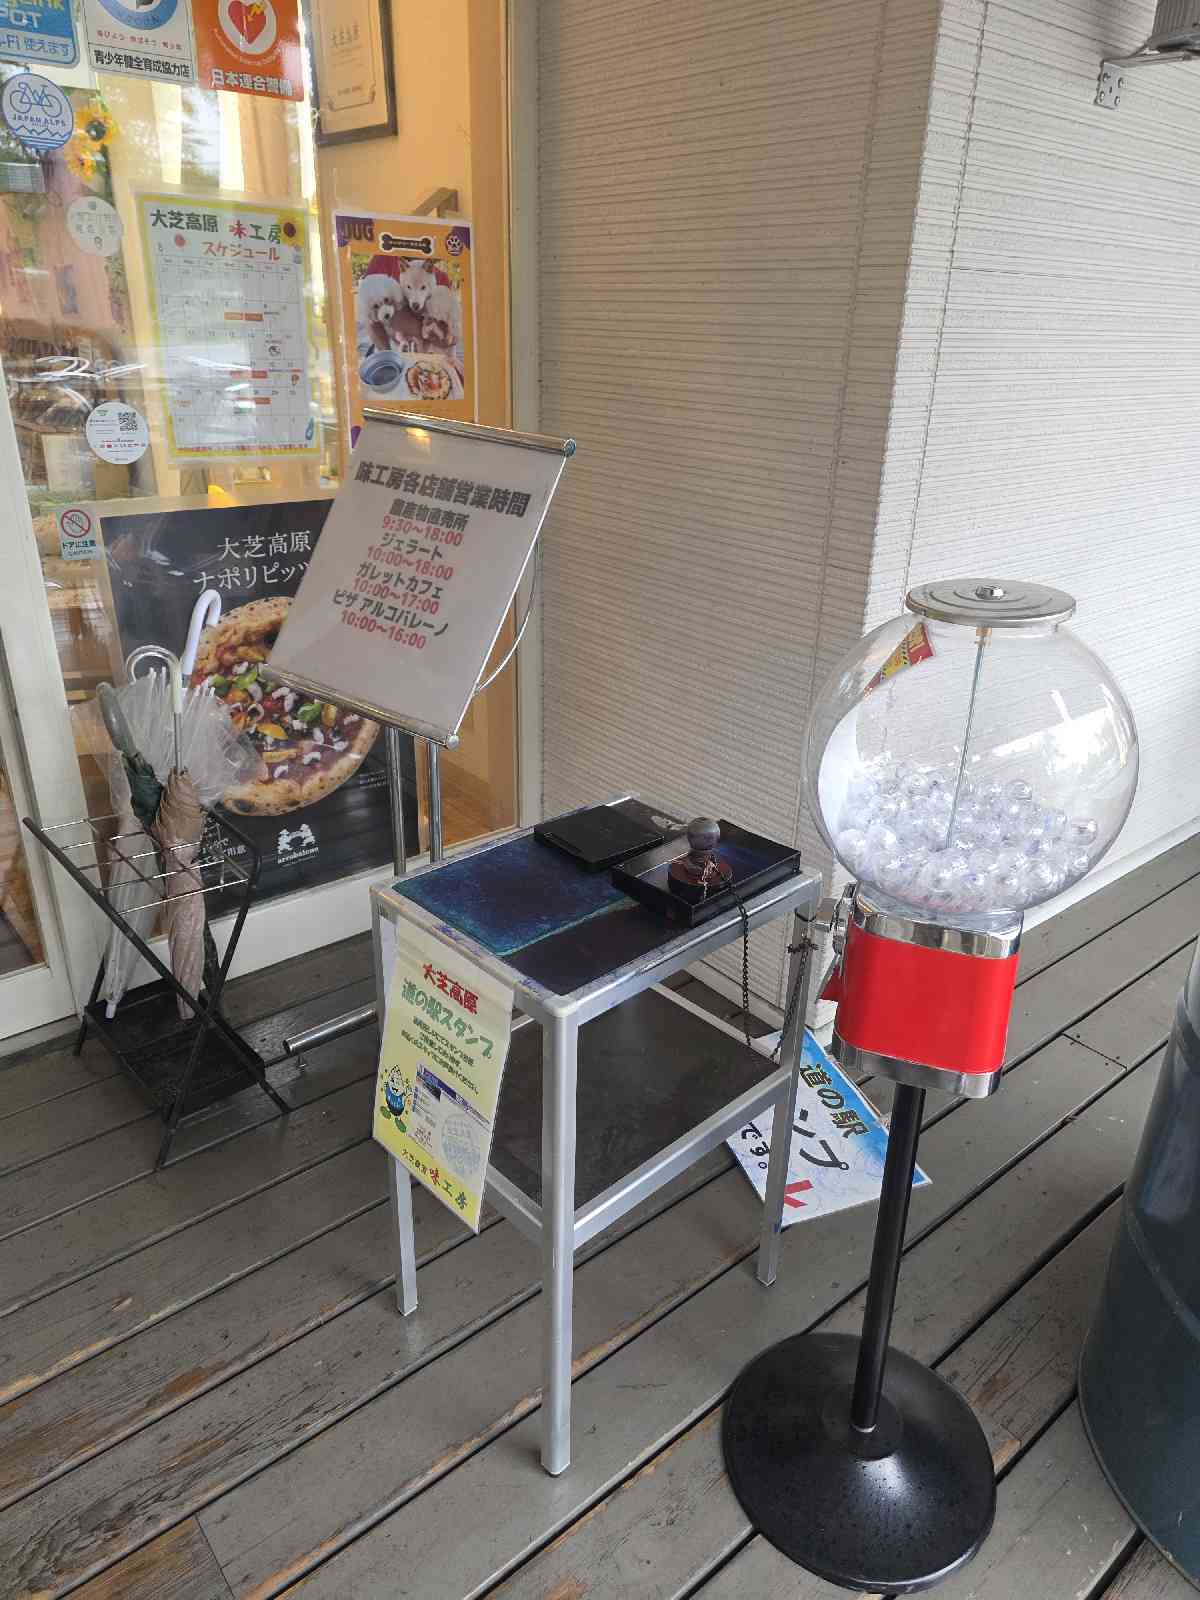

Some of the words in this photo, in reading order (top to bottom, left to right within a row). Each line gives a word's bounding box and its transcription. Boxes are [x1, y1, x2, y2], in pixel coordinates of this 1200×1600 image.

[94, 50, 190, 78] 青少年健全育成協力店
[150, 209, 219, 233] 大芝高原
[202, 241, 280, 260] スケジュール
[355, 461, 531, 517] 味工房各店舗営業時間
[389, 498, 470, 532] 農産物直売所
[217, 530, 312, 560] 大芝高原
[381, 532, 442, 561] ジェラート
[356, 562, 444, 599] ガレットカフェ
[422, 963, 479, 1015] 大芝高原
